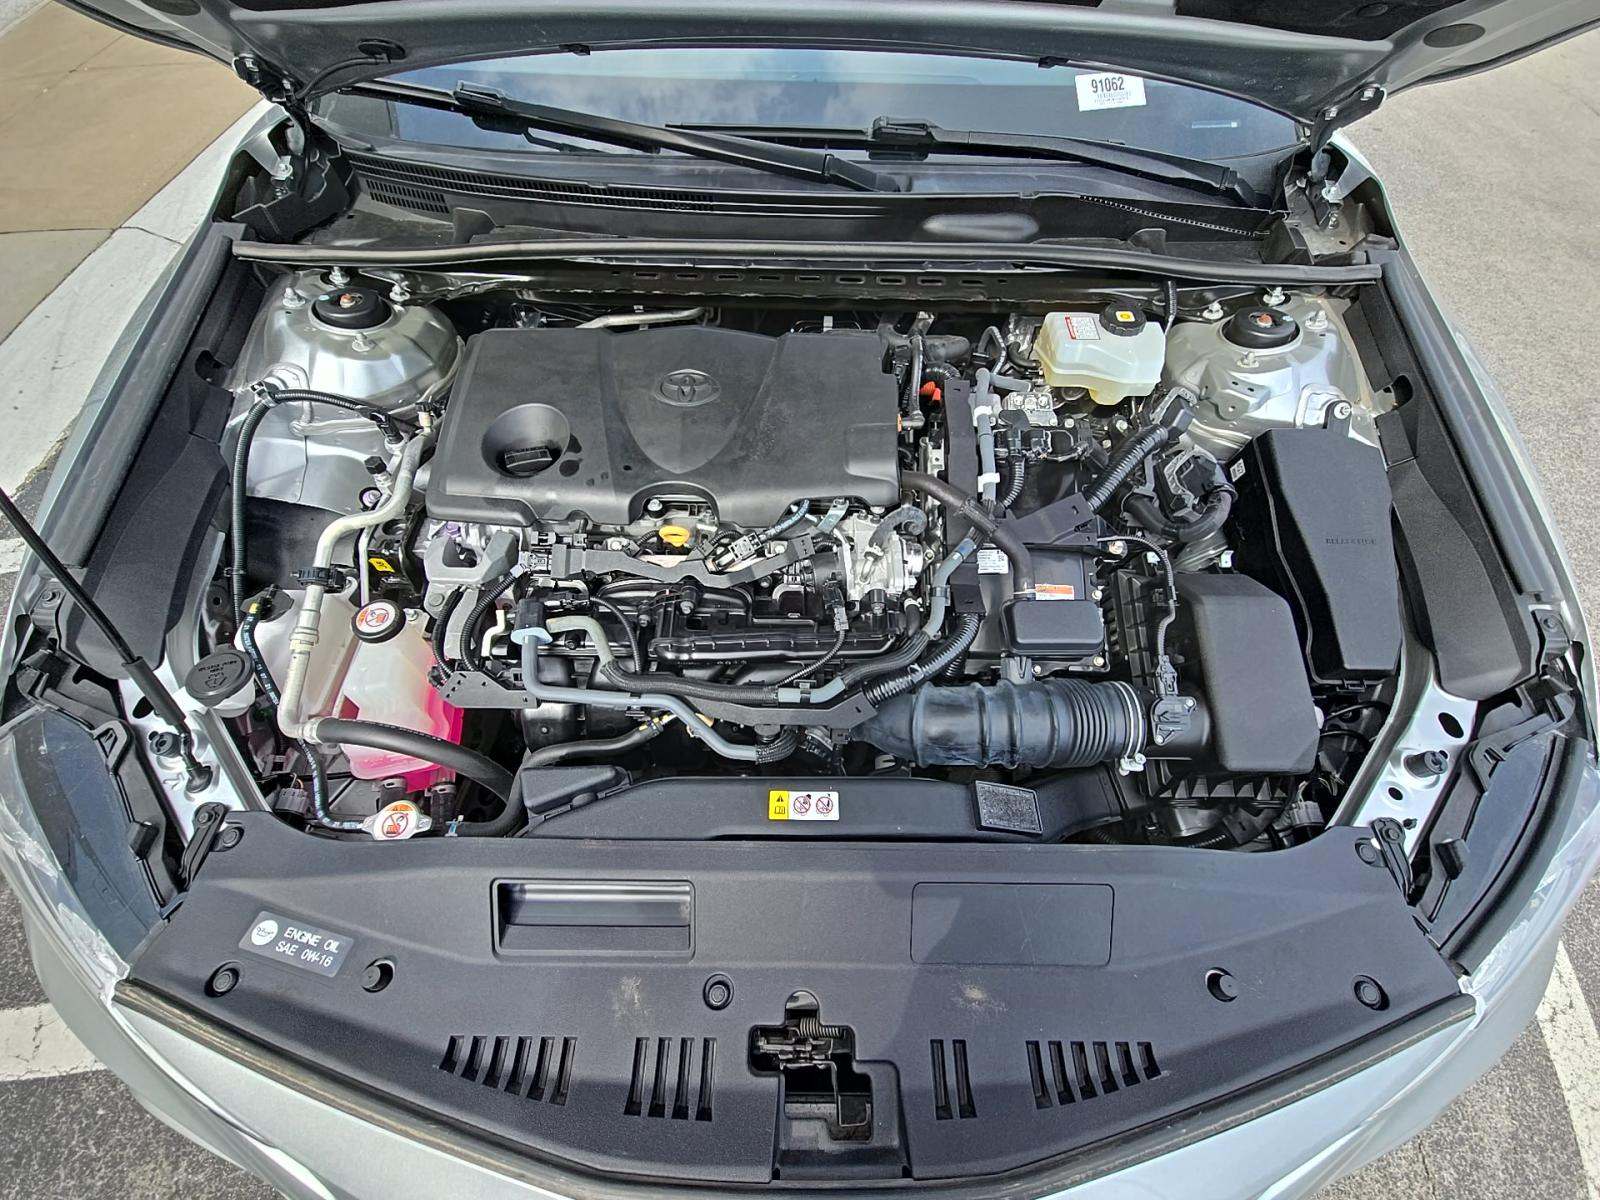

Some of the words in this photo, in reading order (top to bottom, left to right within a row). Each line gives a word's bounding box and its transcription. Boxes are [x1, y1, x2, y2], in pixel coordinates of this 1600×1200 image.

[1091, 76, 1125, 93] 91062
[284, 927, 321, 946] ENGINE
[323, 939, 341, 954] OIL
[276, 941, 299, 956] SAE
[301, 949, 333, 967] 0W-16
